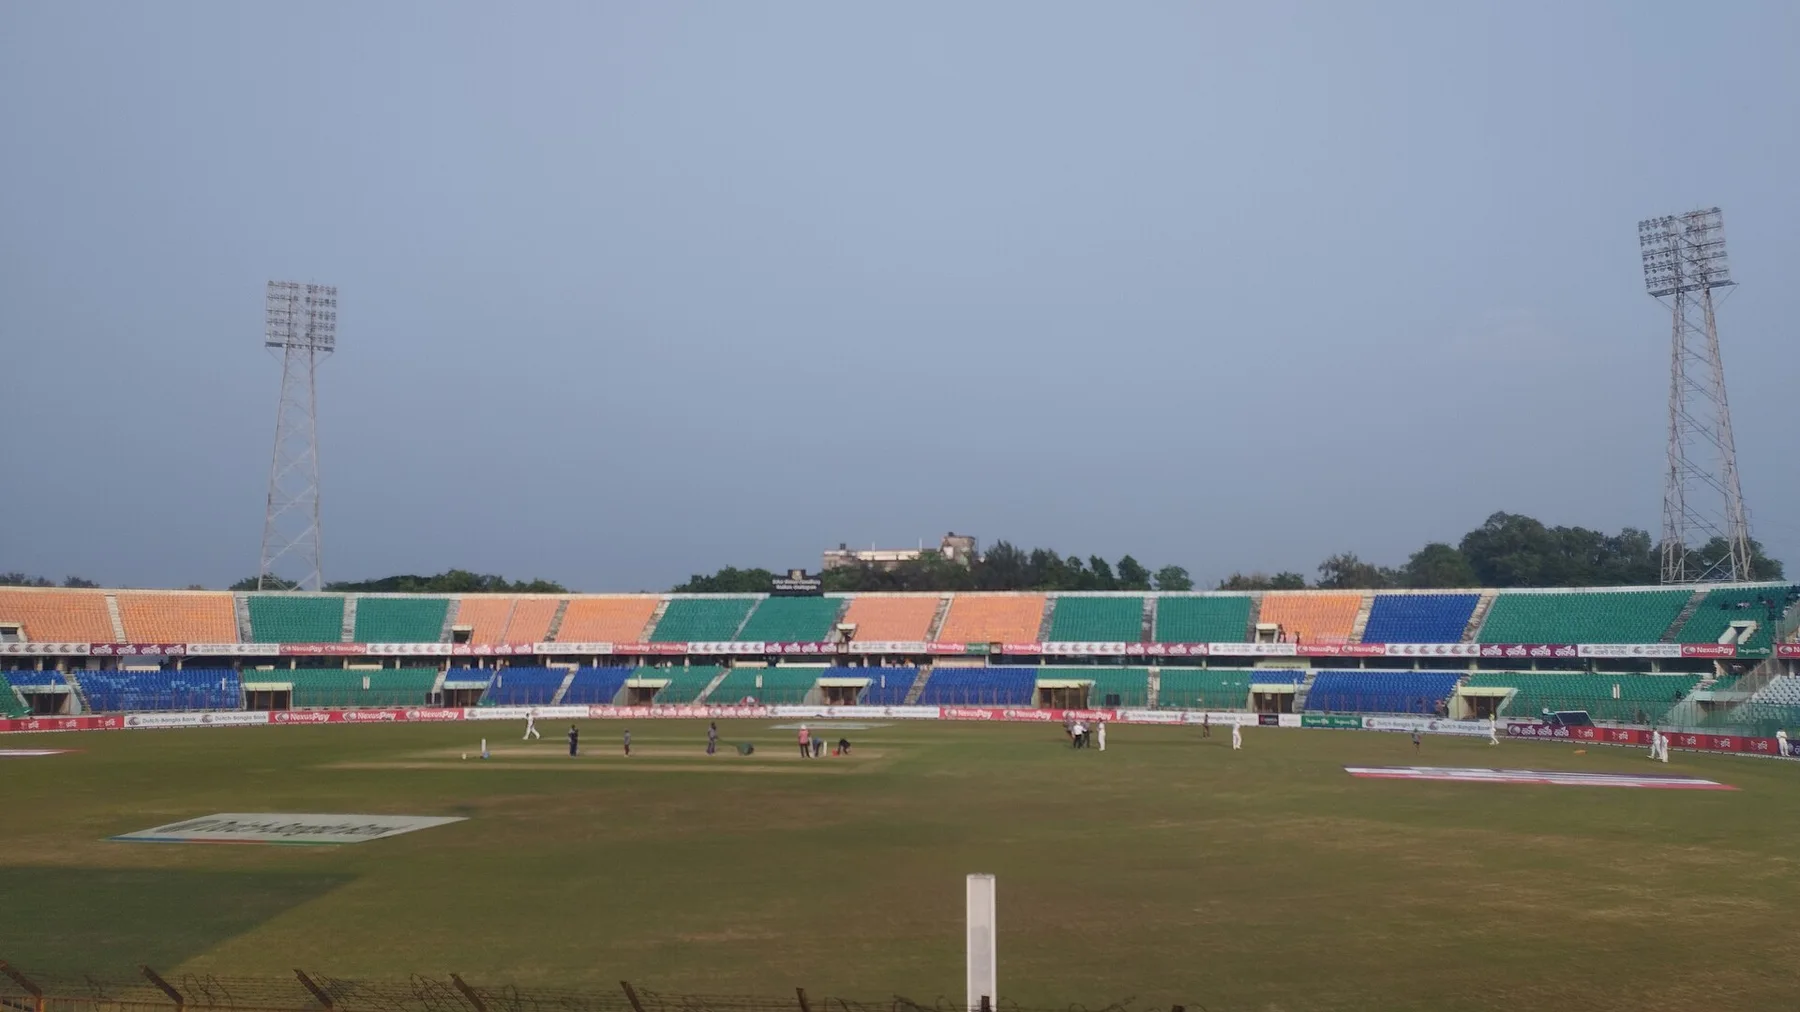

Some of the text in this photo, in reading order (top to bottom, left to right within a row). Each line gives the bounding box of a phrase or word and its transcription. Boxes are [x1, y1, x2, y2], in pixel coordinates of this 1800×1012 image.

[1697, 646, 1734, 655] NexusPay
[290, 711, 330, 722] NexusPay
[357, 711, 397, 722] NexusPay
[421, 710, 459, 720] NexusPay
